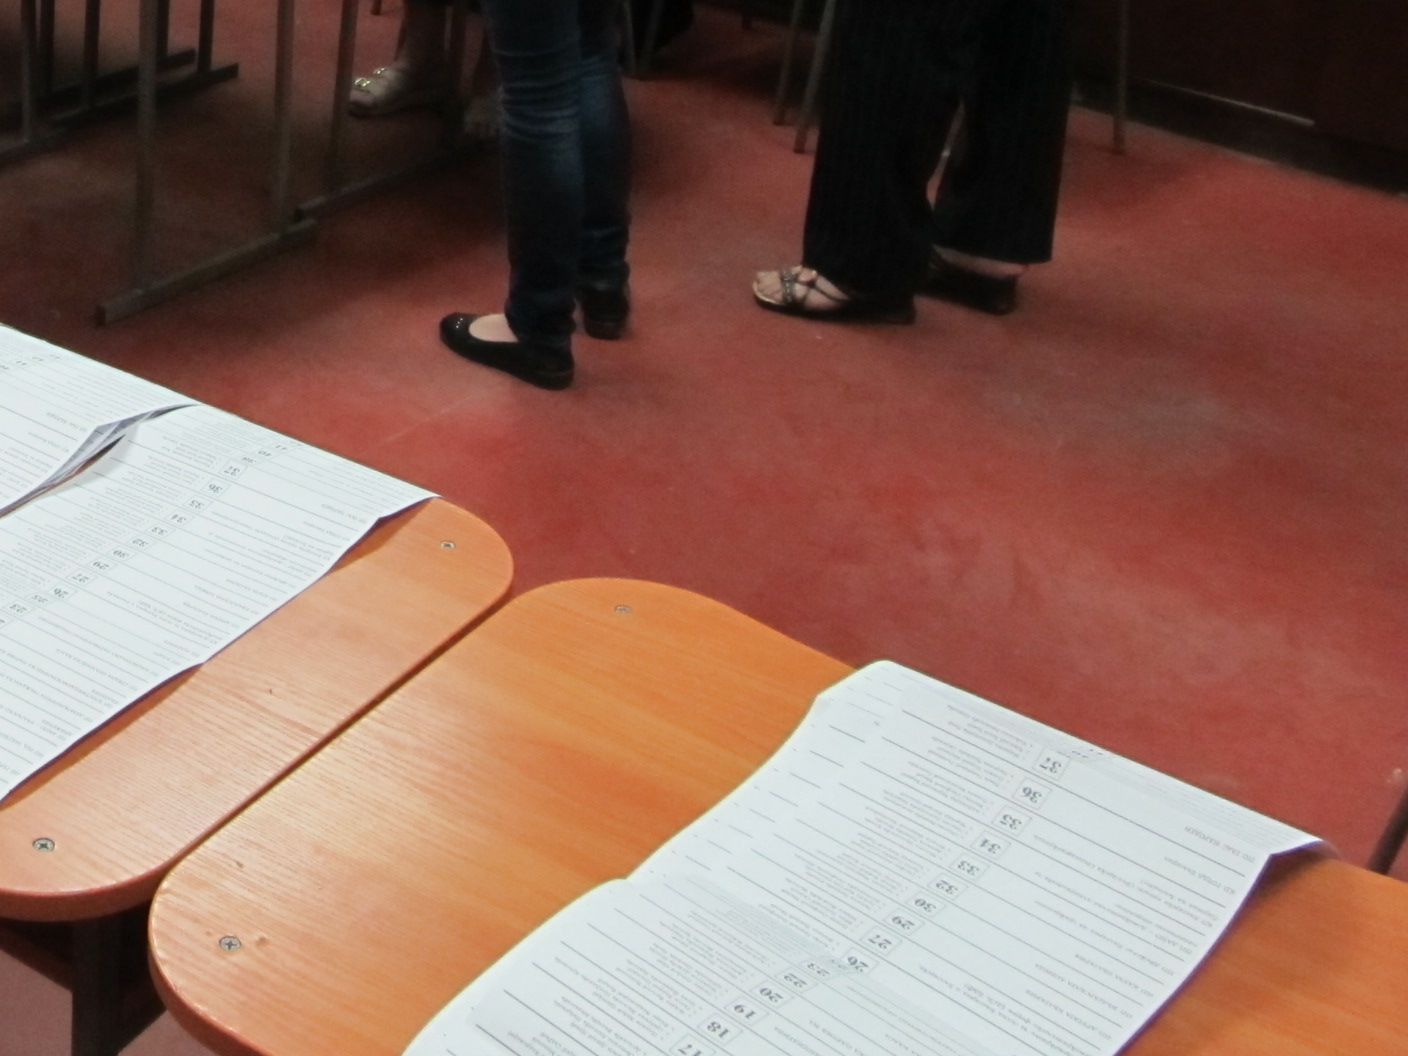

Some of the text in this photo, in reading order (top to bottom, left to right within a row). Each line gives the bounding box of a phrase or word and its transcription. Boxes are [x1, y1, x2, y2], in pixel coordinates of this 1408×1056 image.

[224, 466, 240, 476] 37
[209, 484, 223, 493] 36
[189, 500, 205, 509] 35
[171, 514, 187, 523] 34
[151, 527, 168, 535] 33
[132, 538, 148, 547] 32
[113, 550, 129, 558] 30
[93, 561, 109, 570] 29
[72, 573, 89, 583] 27
[54, 588, 69, 598] 26
[9, 604, 27, 613] 23
[1039, 757, 1061, 773] 37
[1022, 787, 1042, 803] 36
[1000, 814, 1022, 830] 35
[980, 839, 1001, 854] 34
[957, 861, 979, 875] 33
[936, 880, 958, 894] 32
[914, 899, 936, 912] 30
[892, 916, 915, 930] 29
[868, 934, 892, 949] 27
[807, 963, 830, 976] 23
[847, 956, 868, 972] 26
[784, 973, 807, 988] 22
[760, 988, 783, 1002] 20
[734, 1005, 755, 1019] 19
[707, 1021, 729, 1038] 18
